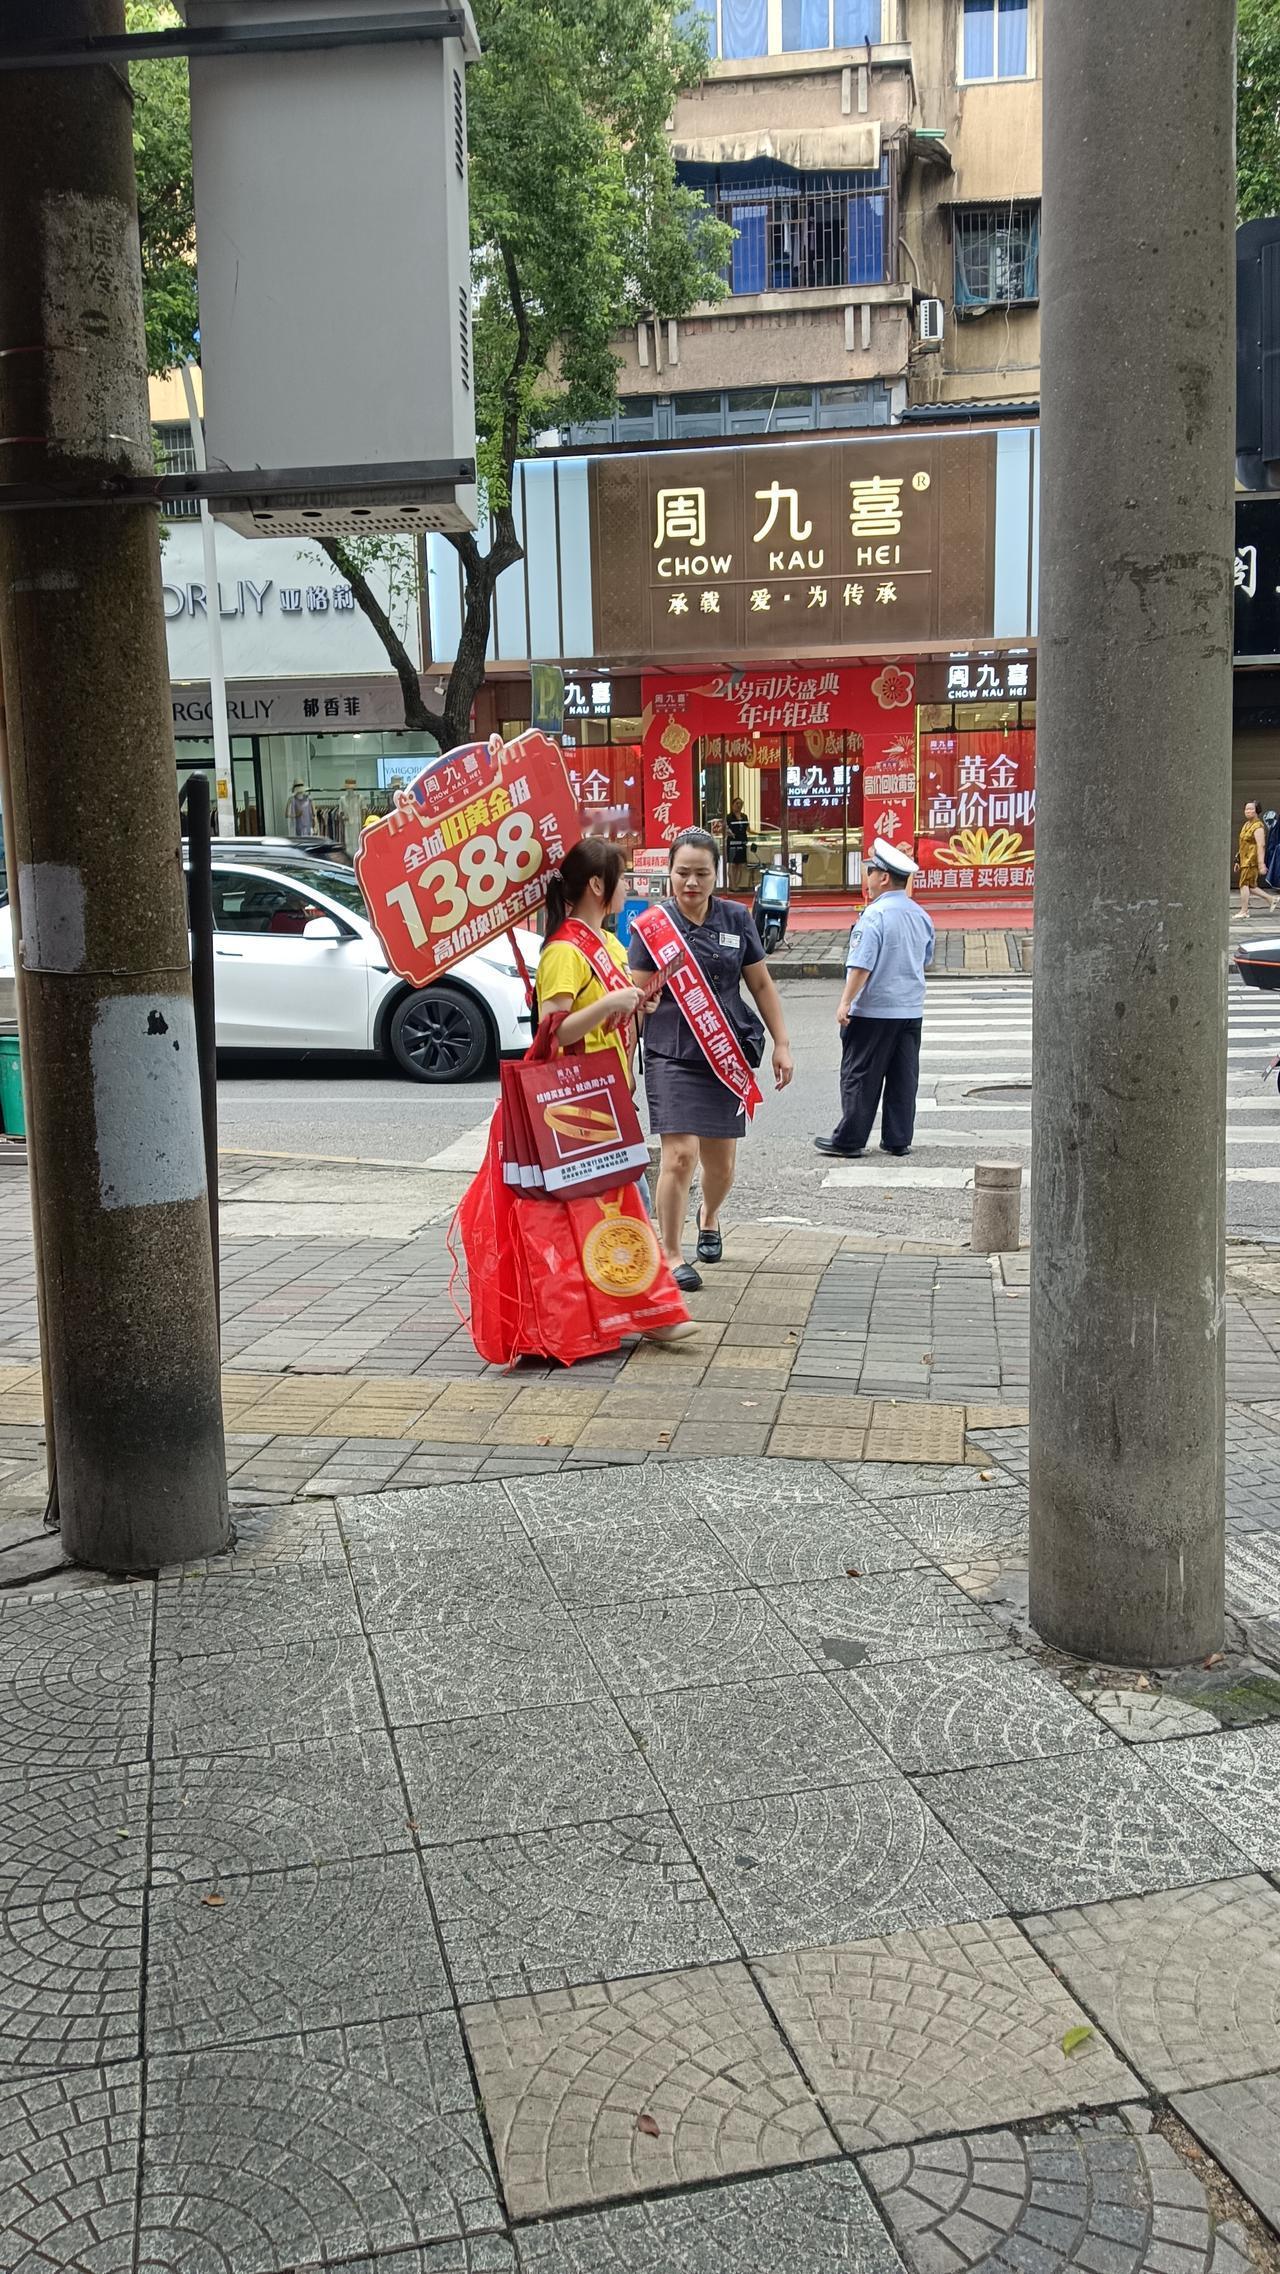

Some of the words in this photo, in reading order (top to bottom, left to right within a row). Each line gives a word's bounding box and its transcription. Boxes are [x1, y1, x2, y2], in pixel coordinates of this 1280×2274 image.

[654, 475, 903, 549] 周九喜
[657, 555, 732, 577] CHOW
[769, 550, 824, 570] KAU
[857, 545, 901, 566] HEI
[280, 585, 355, 612] 亚格莉
[711, 672, 840, 706] 21岁司庆盛典
[947, 663, 1029, 688] 周九喜
[303, 697, 361, 717] 郁香菲
[948, 690, 977, 699] CHOW
[982, 688, 1004, 697] KAU
[1009, 687, 1027, 696] HEI
[569, 706, 590, 714] KAU
[594, 705, 610, 713] HEI
[737, 701, 831, 730] 年中钜惠
[424, 753, 478, 796] 周九喜
[864, 773, 916, 795] 高价回收黄金
[957, 753, 1019, 791] 黄金
[429, 788, 449, 803] CHOW
[452, 778, 467, 791] KAU
[928, 789, 1036, 829] 高价回收
[386, 811, 543, 950] 1388
[913, 868, 975, 889] 品牌直营
